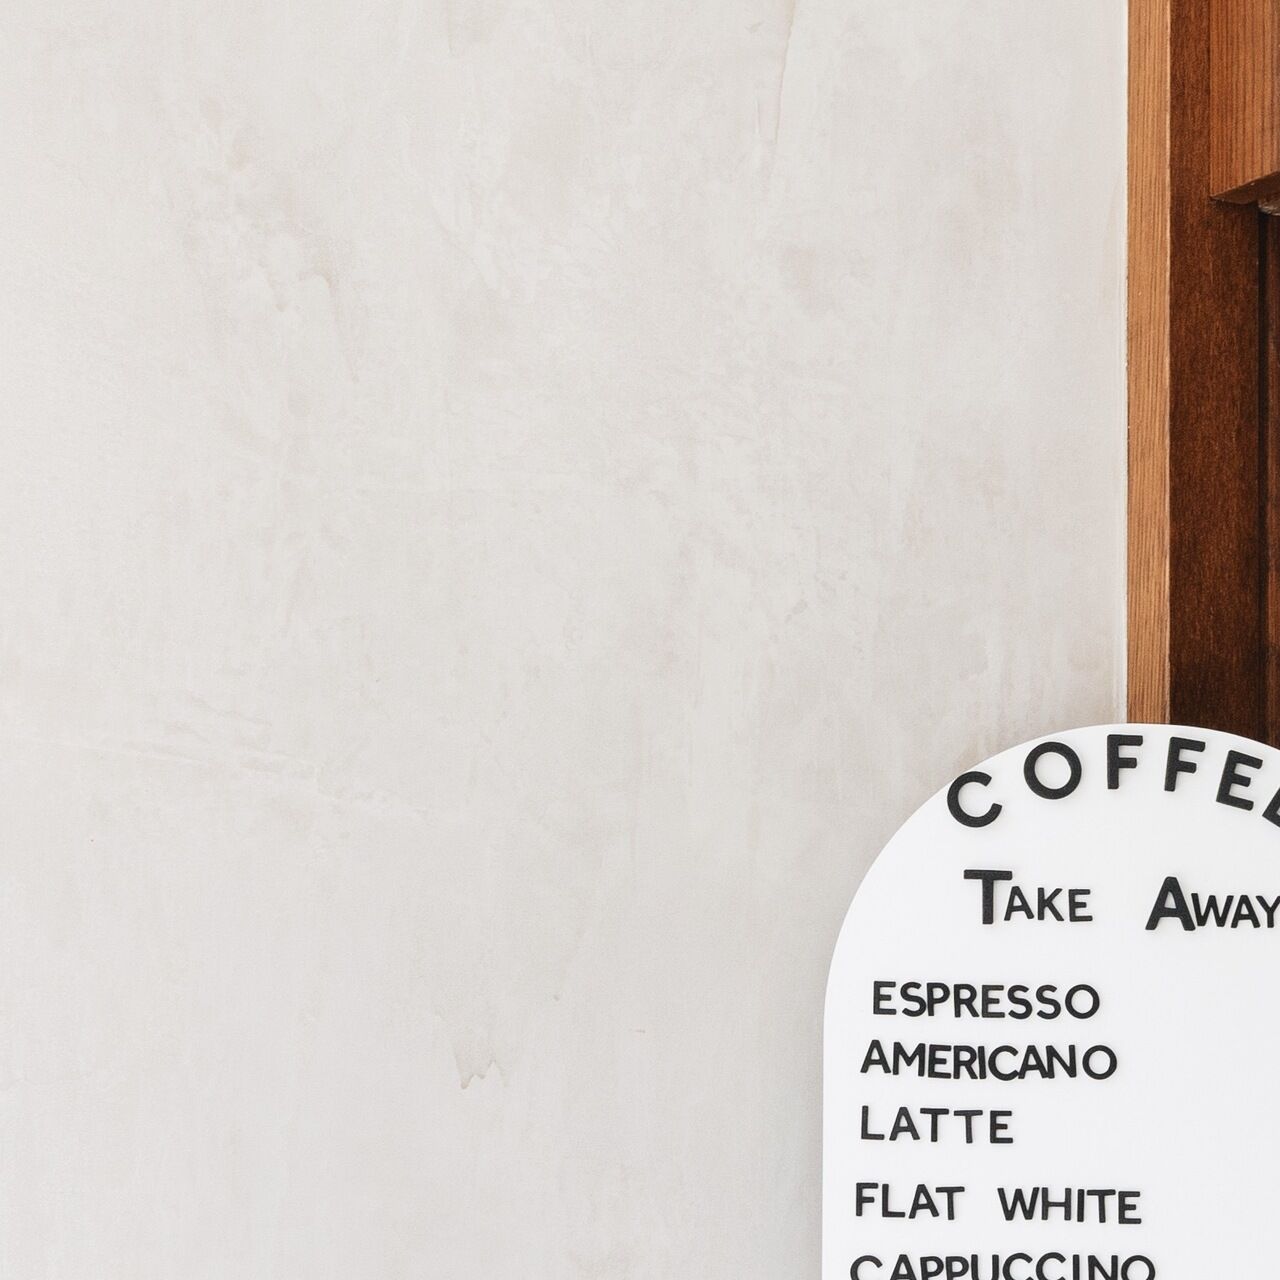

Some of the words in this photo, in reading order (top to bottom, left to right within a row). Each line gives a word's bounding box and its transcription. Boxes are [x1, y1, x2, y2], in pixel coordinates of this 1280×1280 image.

[874, 981, 1099, 1019] ESPRESSO
[861, 1040, 1117, 1081] AMERICANO
[860, 1106, 1013, 1143] LATTE
[856, 1183, 965, 1220] FLAT
[998, 1187, 1142, 1225] WHITE
